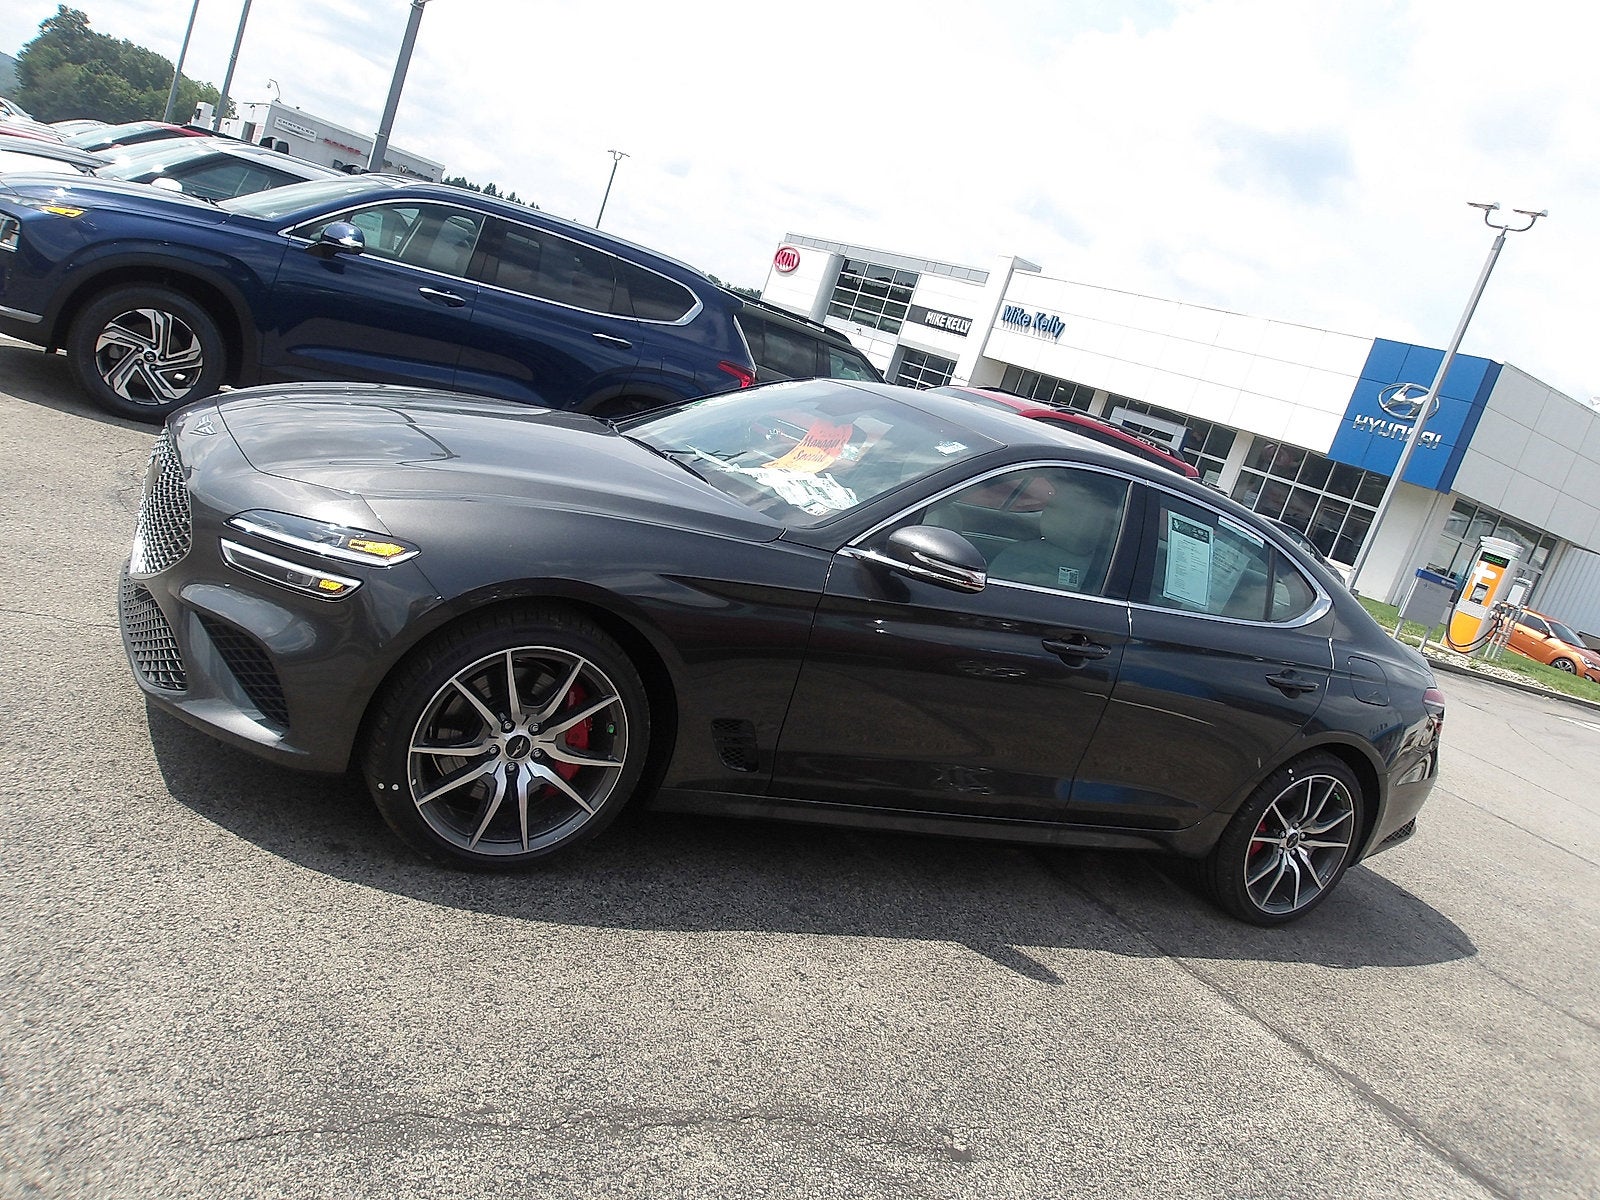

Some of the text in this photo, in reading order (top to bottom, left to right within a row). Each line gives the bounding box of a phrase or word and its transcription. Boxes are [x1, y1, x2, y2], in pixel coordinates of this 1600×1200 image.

[775, 250, 796, 268] KIA
[924, 311, 972, 333] MIKE KELLY
[1001, 305, 1065, 338] Mike Kelly
